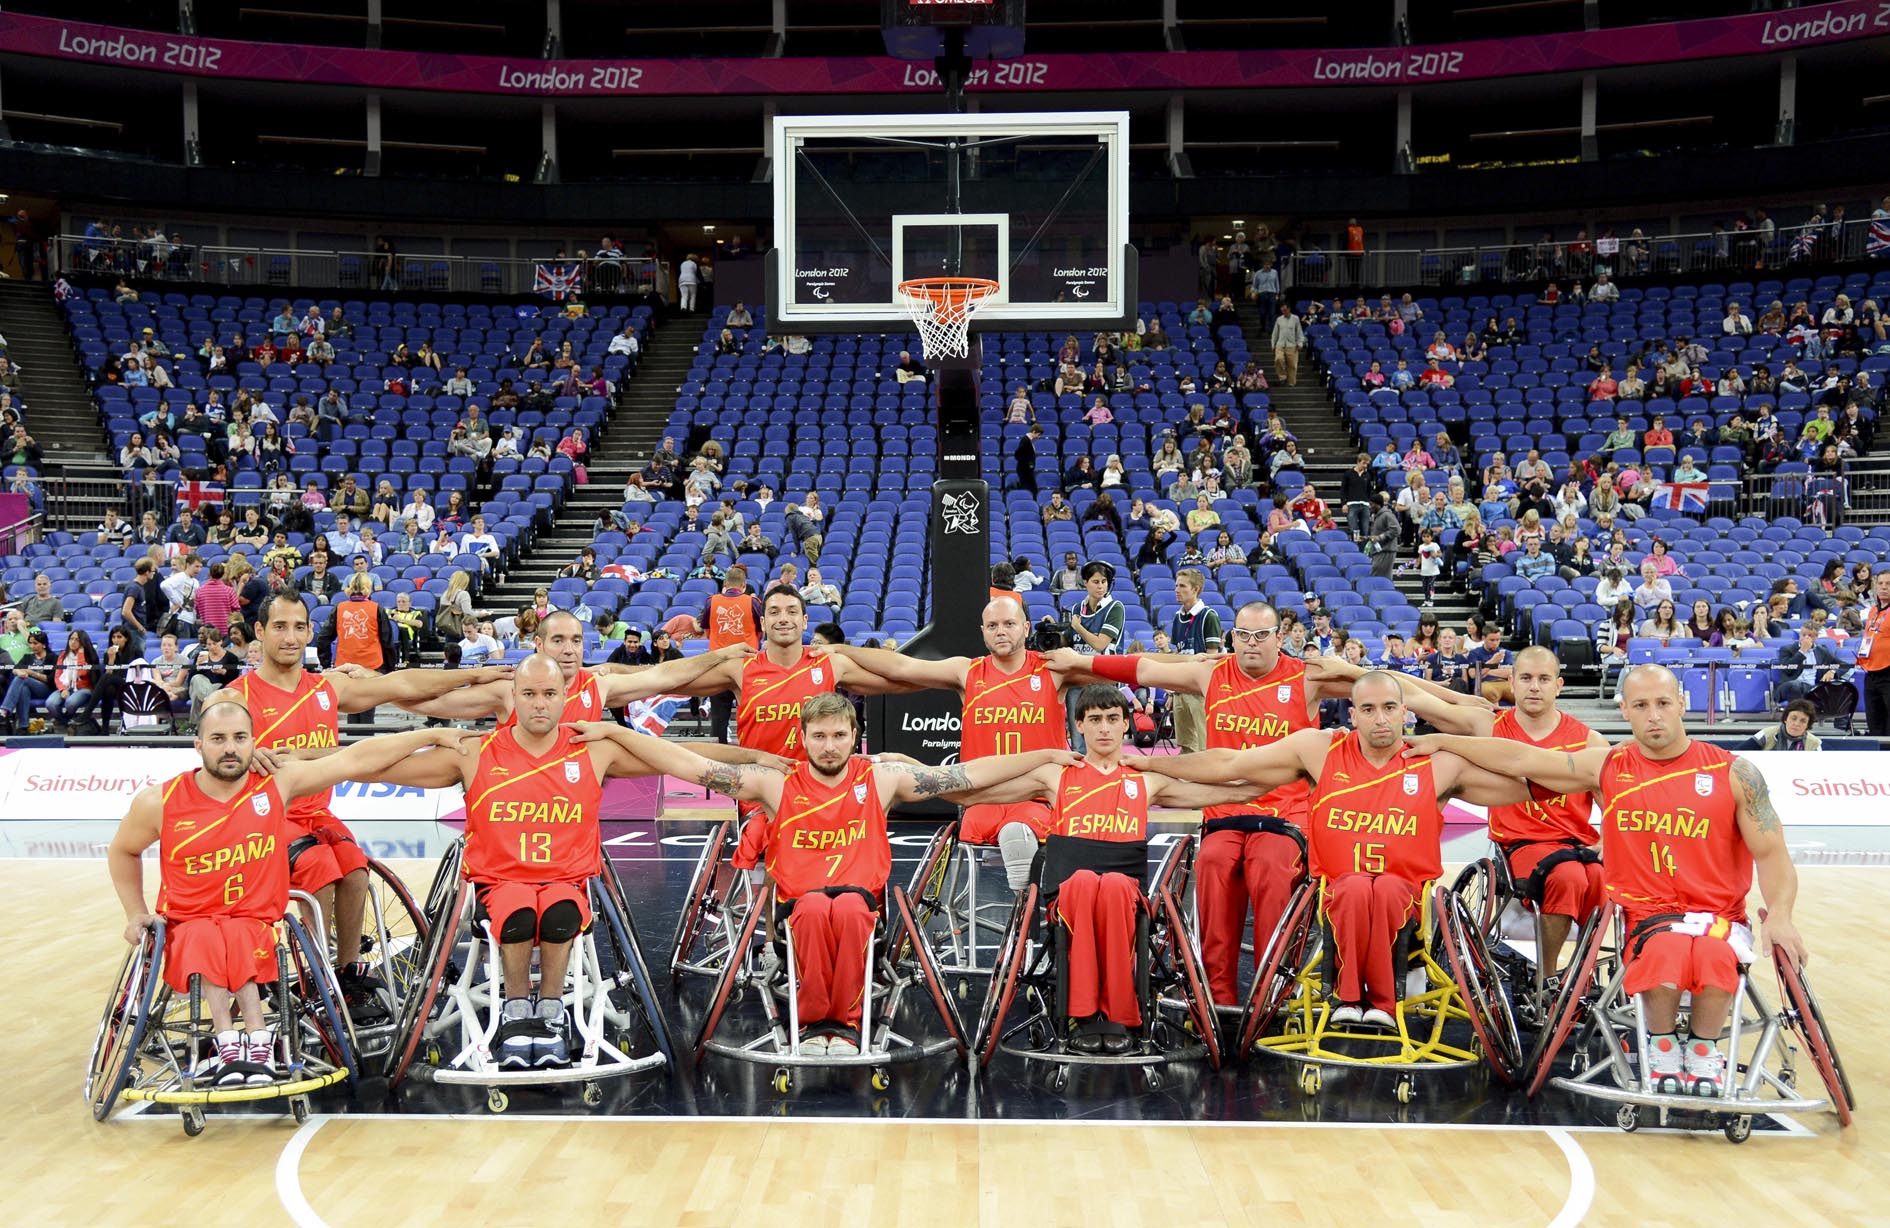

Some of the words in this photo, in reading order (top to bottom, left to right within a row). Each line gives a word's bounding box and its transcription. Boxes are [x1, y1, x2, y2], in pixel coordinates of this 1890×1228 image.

[1761, 10, 1867, 44] London
[58, 28, 157, 63] London
[163, 42, 222, 70] 2012
[499, 65, 585, 90] London
[589, 67, 643, 89] 2012
[994, 62, 1048, 85] 2012
[1313, 54, 1402, 79] London
[1407, 51, 1464, 76] 2012
[795, 267, 827, 278] London
[828, 268, 849, 277] 2012
[1053, 267, 1086, 277] London
[1087, 267, 1108, 277] 2012
[755, 695, 814, 723] ESPA
[901, 711, 962, 731] Londo
[974, 701, 1046, 725] ESPAÑA
[272, 723, 337, 751] ESPAÑA
[784, 726, 797, 750] 4
[1215, 712, 1290, 737] ESPAÑA
[922, 738, 961, 750] Paralymp
[995, 731, 1022, 756] 10
[23, 774, 159, 796] Sainsbury's
[488, 796, 583, 824] ESPAÑA
[1068, 807, 1139, 837] ESPAÑA
[1327, 807, 1418, 837] ESPAÑA
[1616, 807, 1711, 840] ESPAÑA
[519, 832, 552, 863] 13
[791, 819, 867, 850] ESPAÑA
[184, 832, 276, 875] ESPAÑA
[824, 853, 844, 878] 7
[1353, 842, 1386, 874] 15
[1650, 841, 1678, 878] 14
[223, 872, 244, 906] 6
